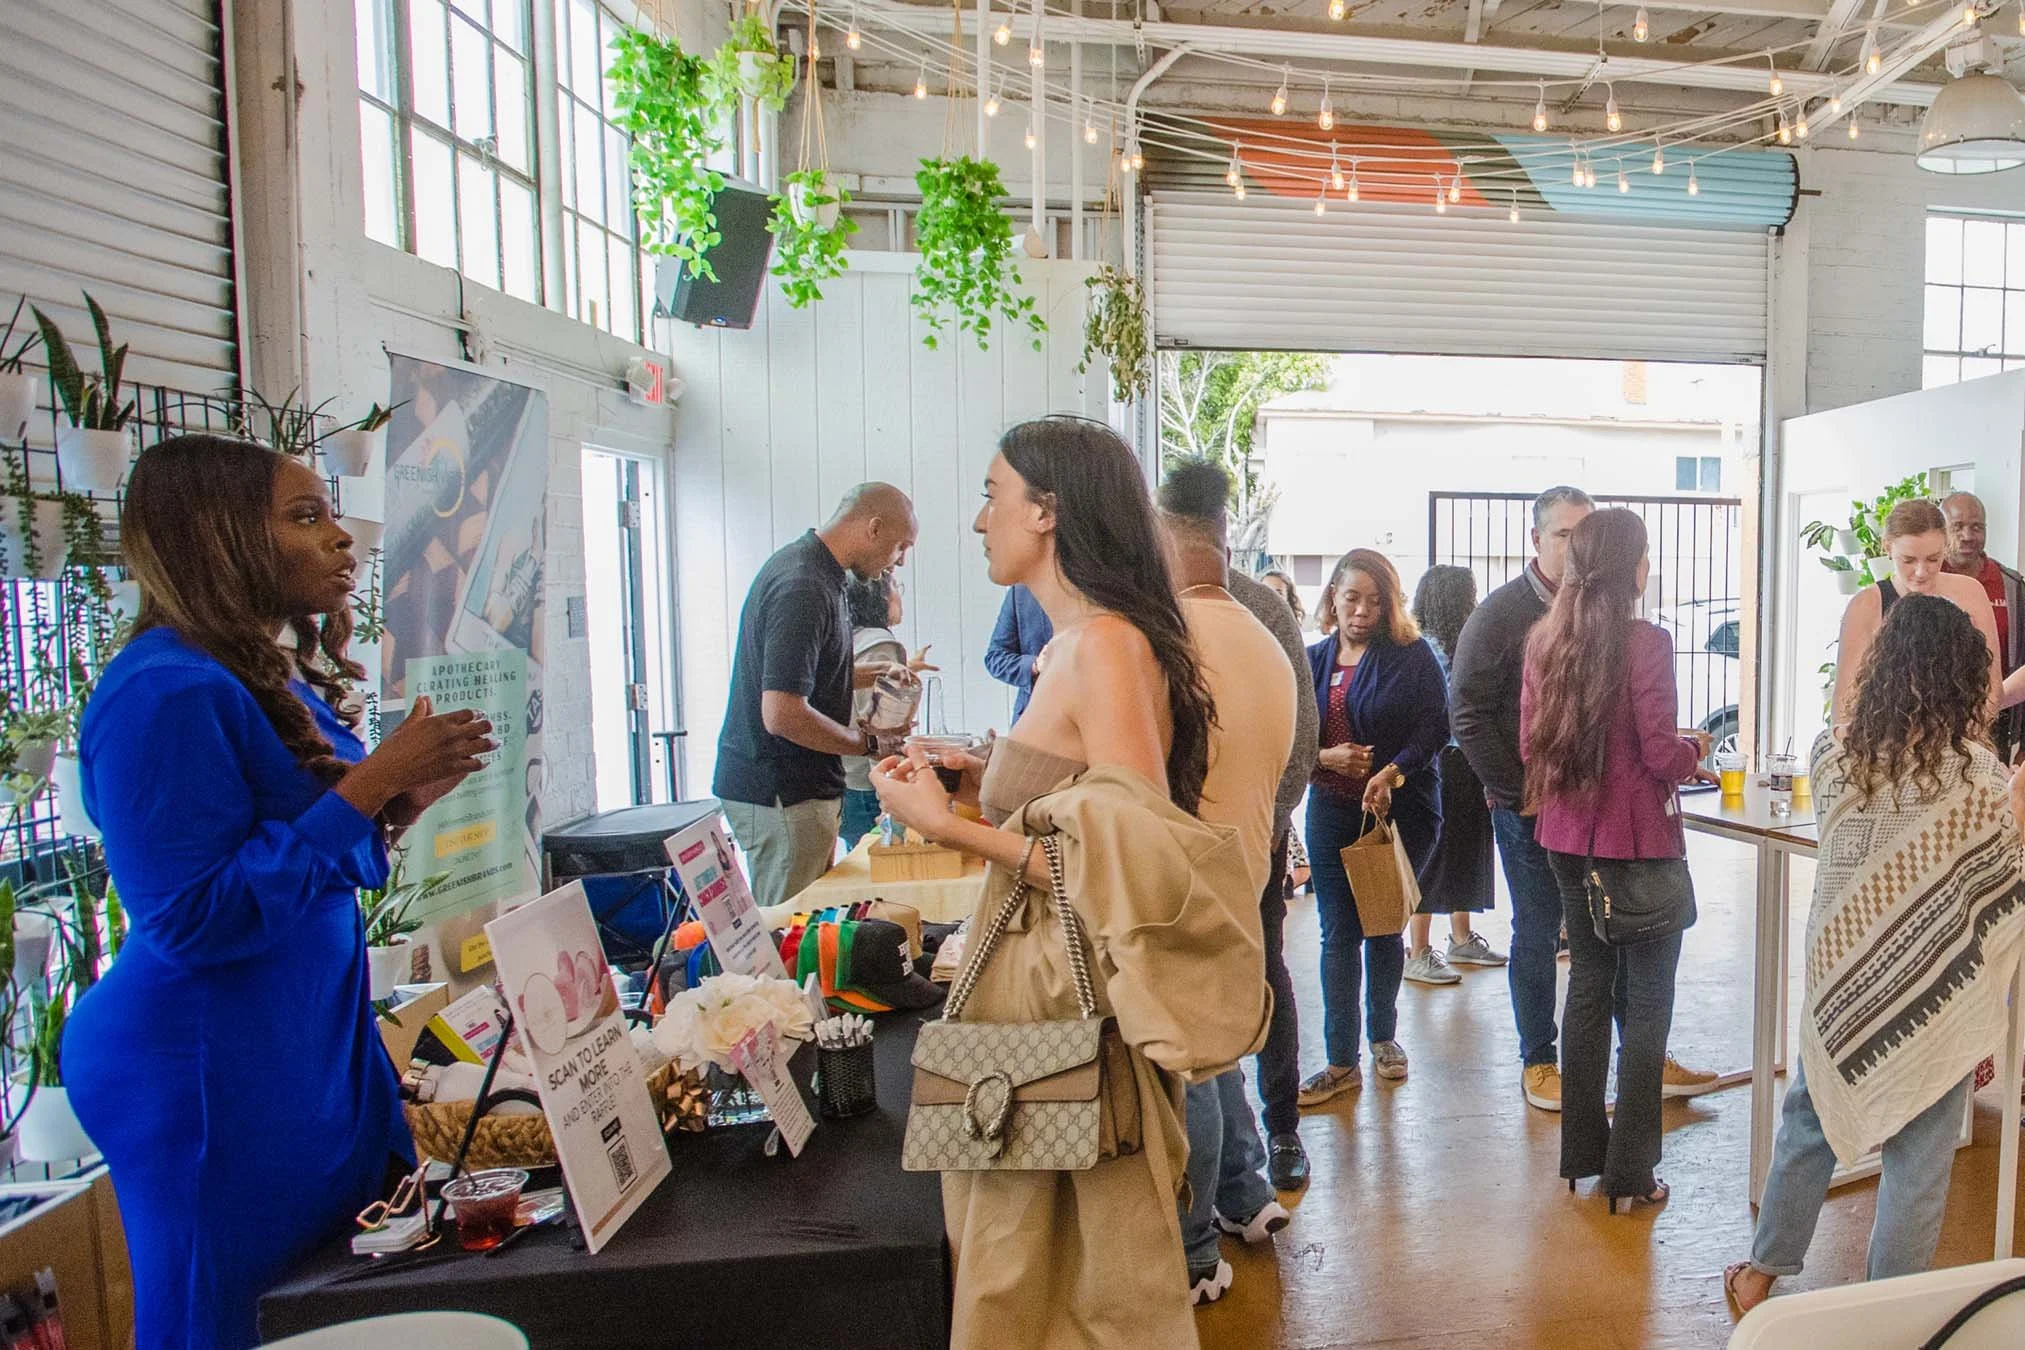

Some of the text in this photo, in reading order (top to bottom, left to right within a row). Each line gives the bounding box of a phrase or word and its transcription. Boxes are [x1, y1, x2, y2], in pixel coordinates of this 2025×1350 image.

[432, 660, 501, 676] APOTHECARY
[548, 1023, 622, 1091] SCAN TO LEARN
[578, 1059, 609, 1093] MORE
